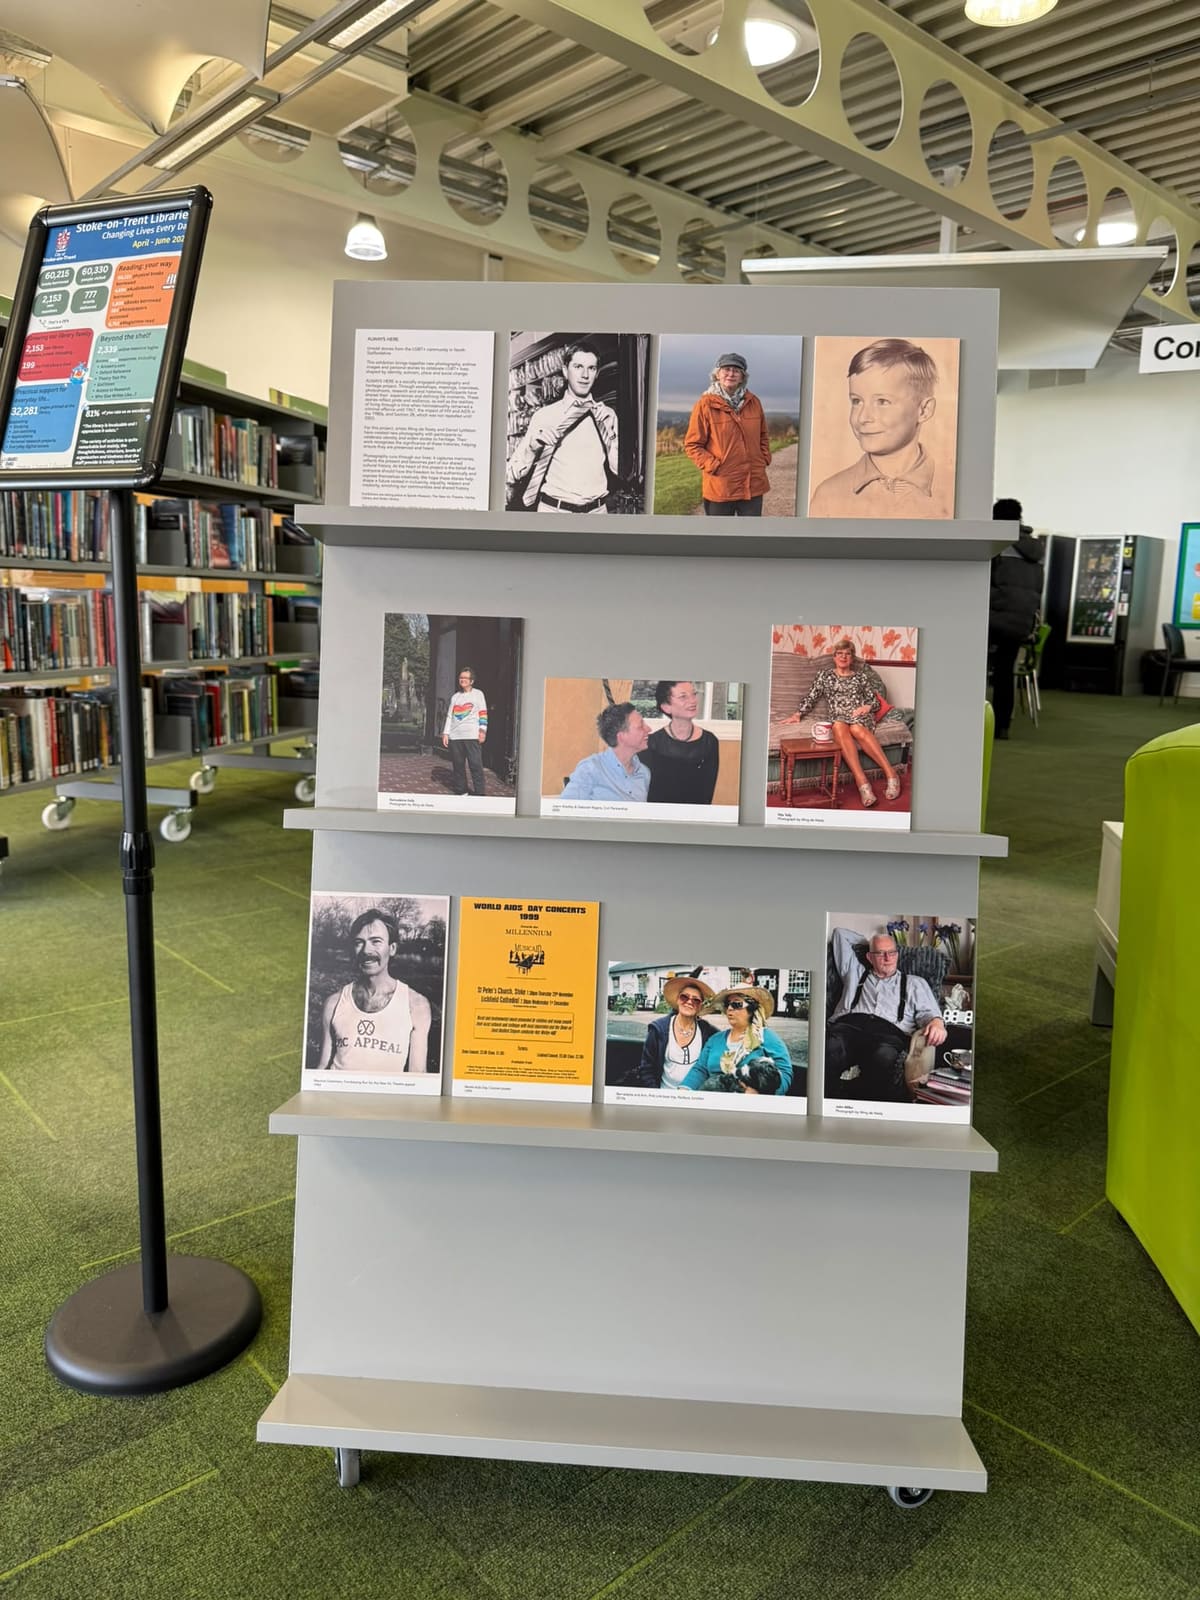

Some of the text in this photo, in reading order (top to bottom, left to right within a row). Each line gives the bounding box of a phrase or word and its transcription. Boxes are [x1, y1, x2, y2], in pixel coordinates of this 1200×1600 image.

[76, 214, 149, 233] Stoke-on-Trent
[102, 229, 135, 240] Changing
[136, 226, 155, 236] Lives
[156, 224, 176, 234] Every
[132, 238, 150, 249] April
[154, 237, 171, 246] June
[44, 270, 70, 280] 60,215
[81, 265, 109, 276] 60,330
[42, 294, 62, 304] 2,153
[84, 290, 98, 299] 777
[100, 334, 124, 343] Beyond
[25, 344, 44, 354] 2,153
[10, 406, 38, 417] 32,281
[85, 409, 100, 418] 81%
[474, 902, 502, 910] WORLD
[545, 906, 586, 914] CONCERTS
[354, 1036, 402, 1054] APPEAL
